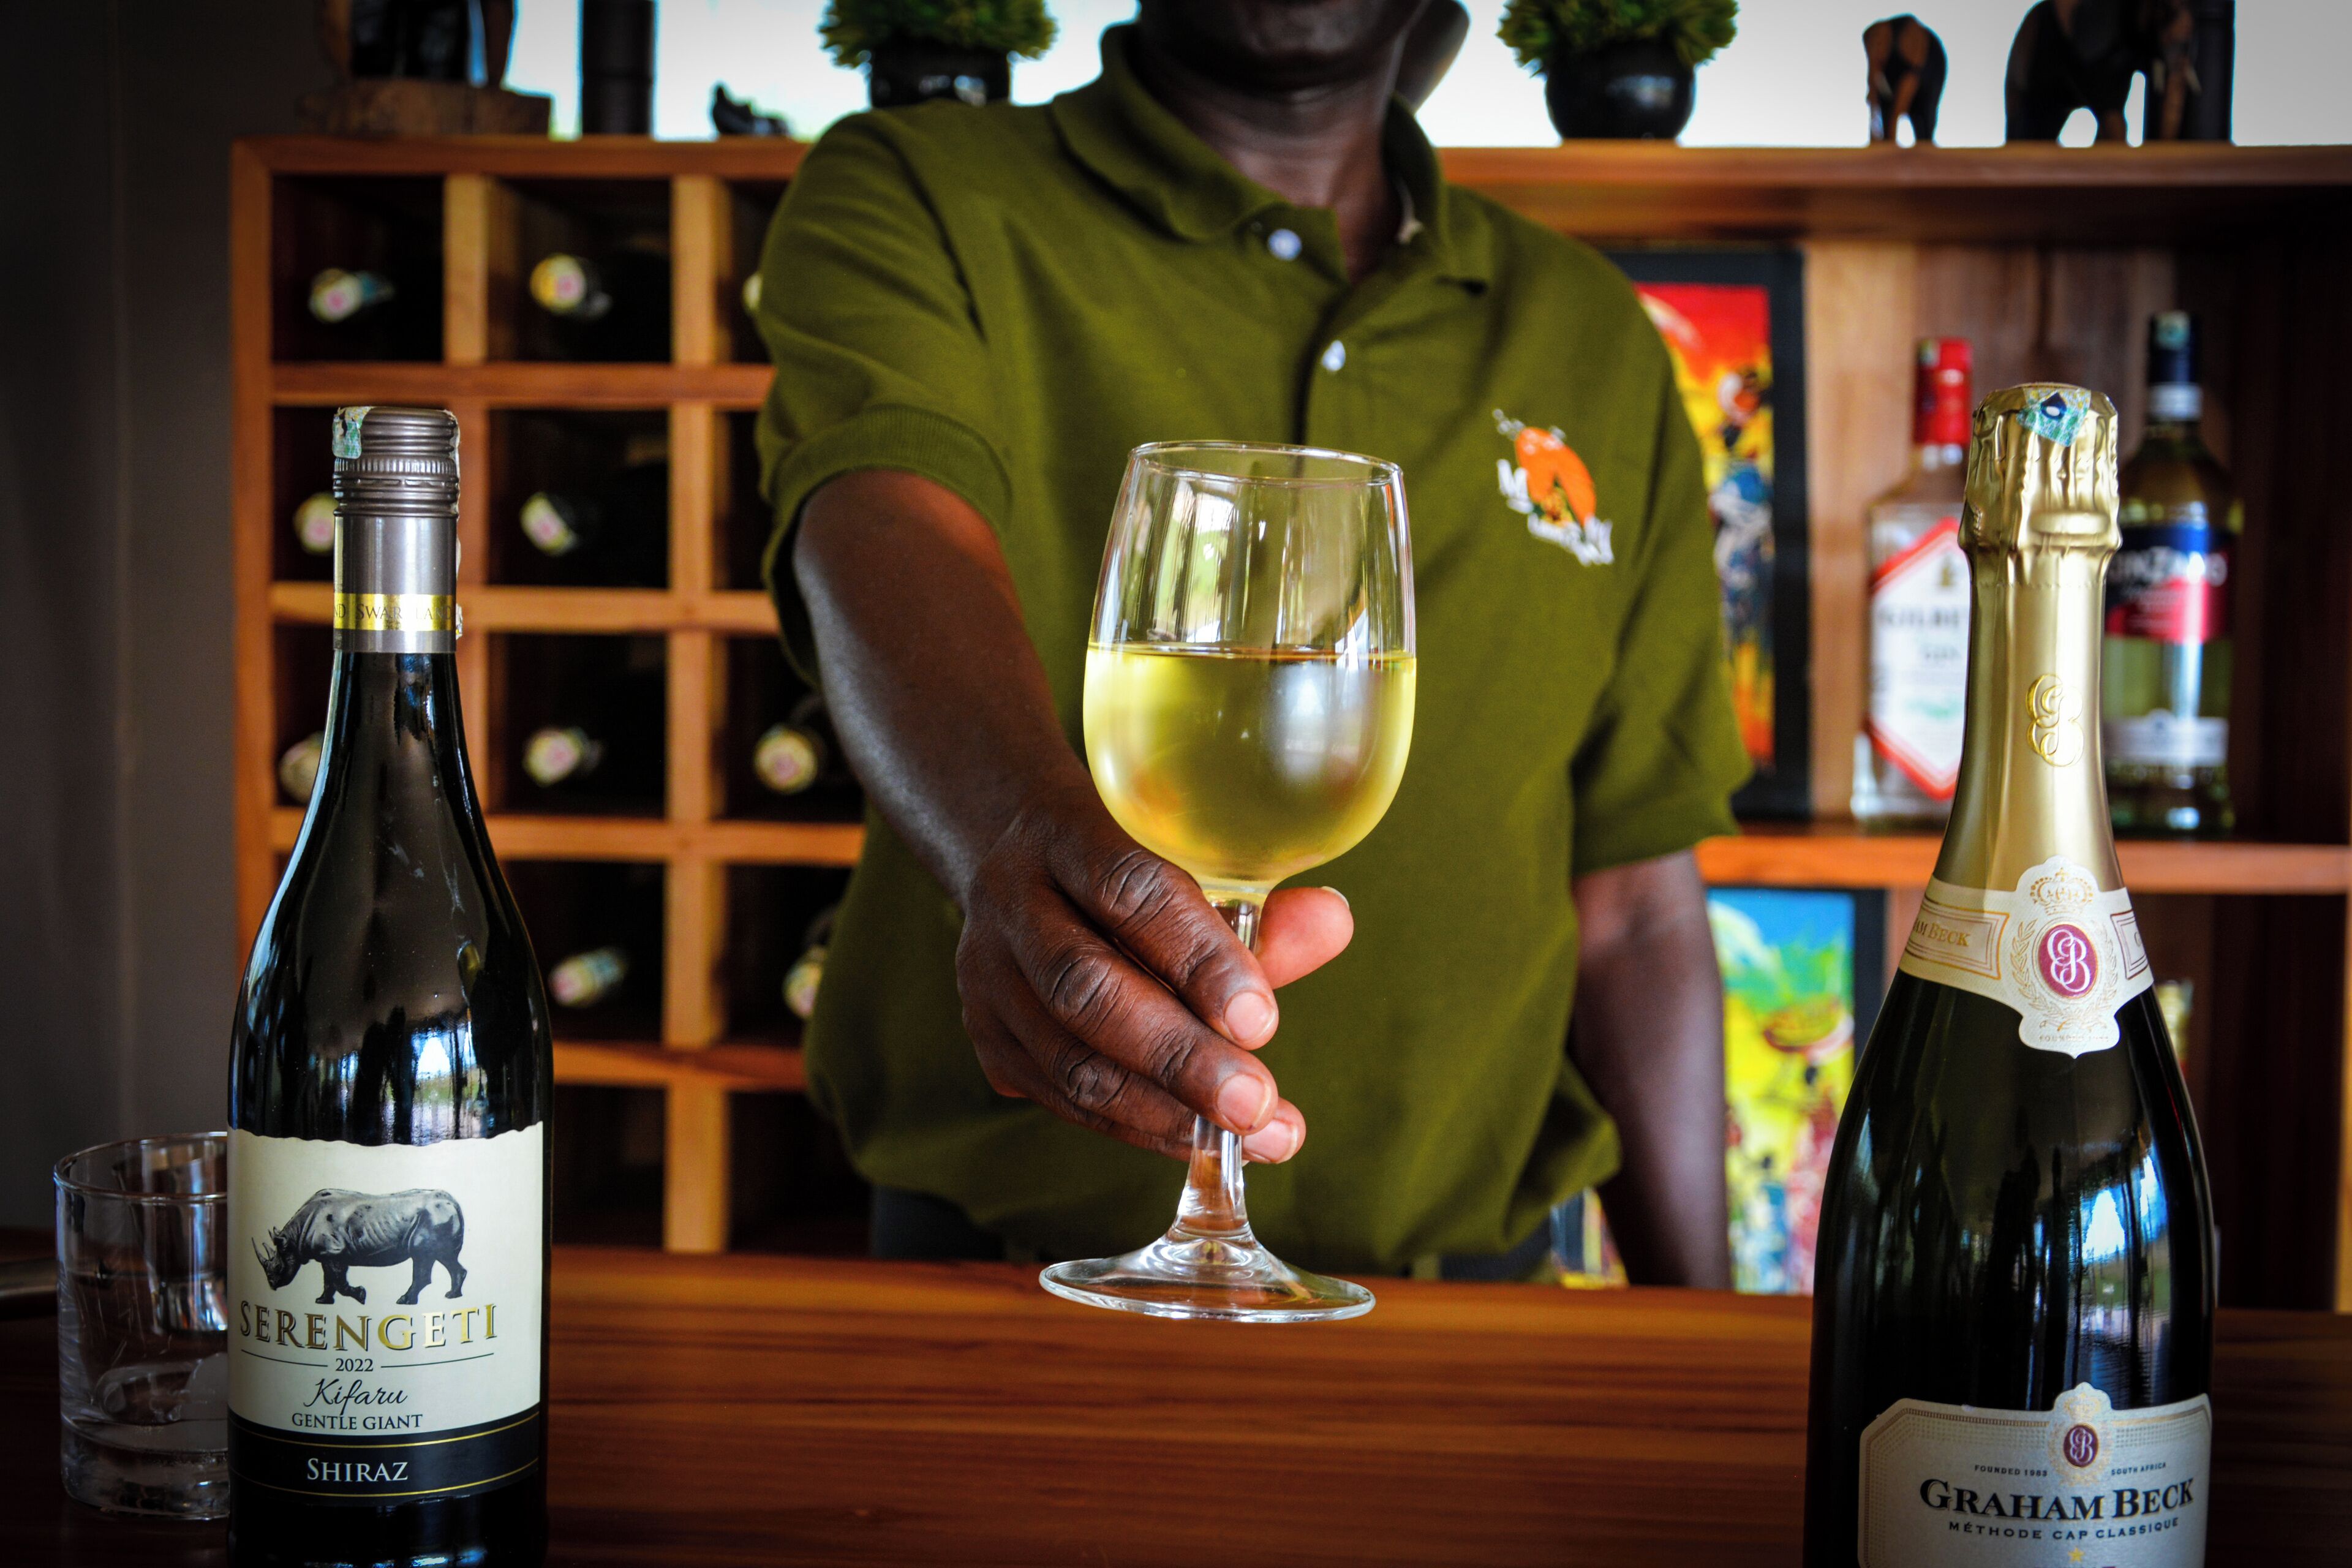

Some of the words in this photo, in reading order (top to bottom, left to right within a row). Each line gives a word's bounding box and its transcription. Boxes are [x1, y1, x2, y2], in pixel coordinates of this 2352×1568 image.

[355, 604, 452, 620] SWARLAND
[1928, 922, 1970, 947] BECK
[240, 1301, 497, 1352] SERENGETI
[335, 1358, 374, 1373] 2022
[303, 1378, 408, 1415] Kifaru
[292, 1412, 358, 1431] GENTLE
[363, 1413, 423, 1430] GIANT
[307, 1457, 409, 1482] SHIRAZ
[1975, 1464, 2020, 1476] FOUNDED
[2111, 1467, 2138, 1476] SOUTH
[2140, 1461, 2166, 1472] AFRICA
[1920, 1478, 2105, 1521] GRAHAM
[2113, 1477, 2195, 1518] BECK
[1949, 1521, 2042, 1540] MÉTHODE
[2052, 1530, 2088, 1540] CAP
[2095, 1517, 2179, 1539] CLASSIQUE
